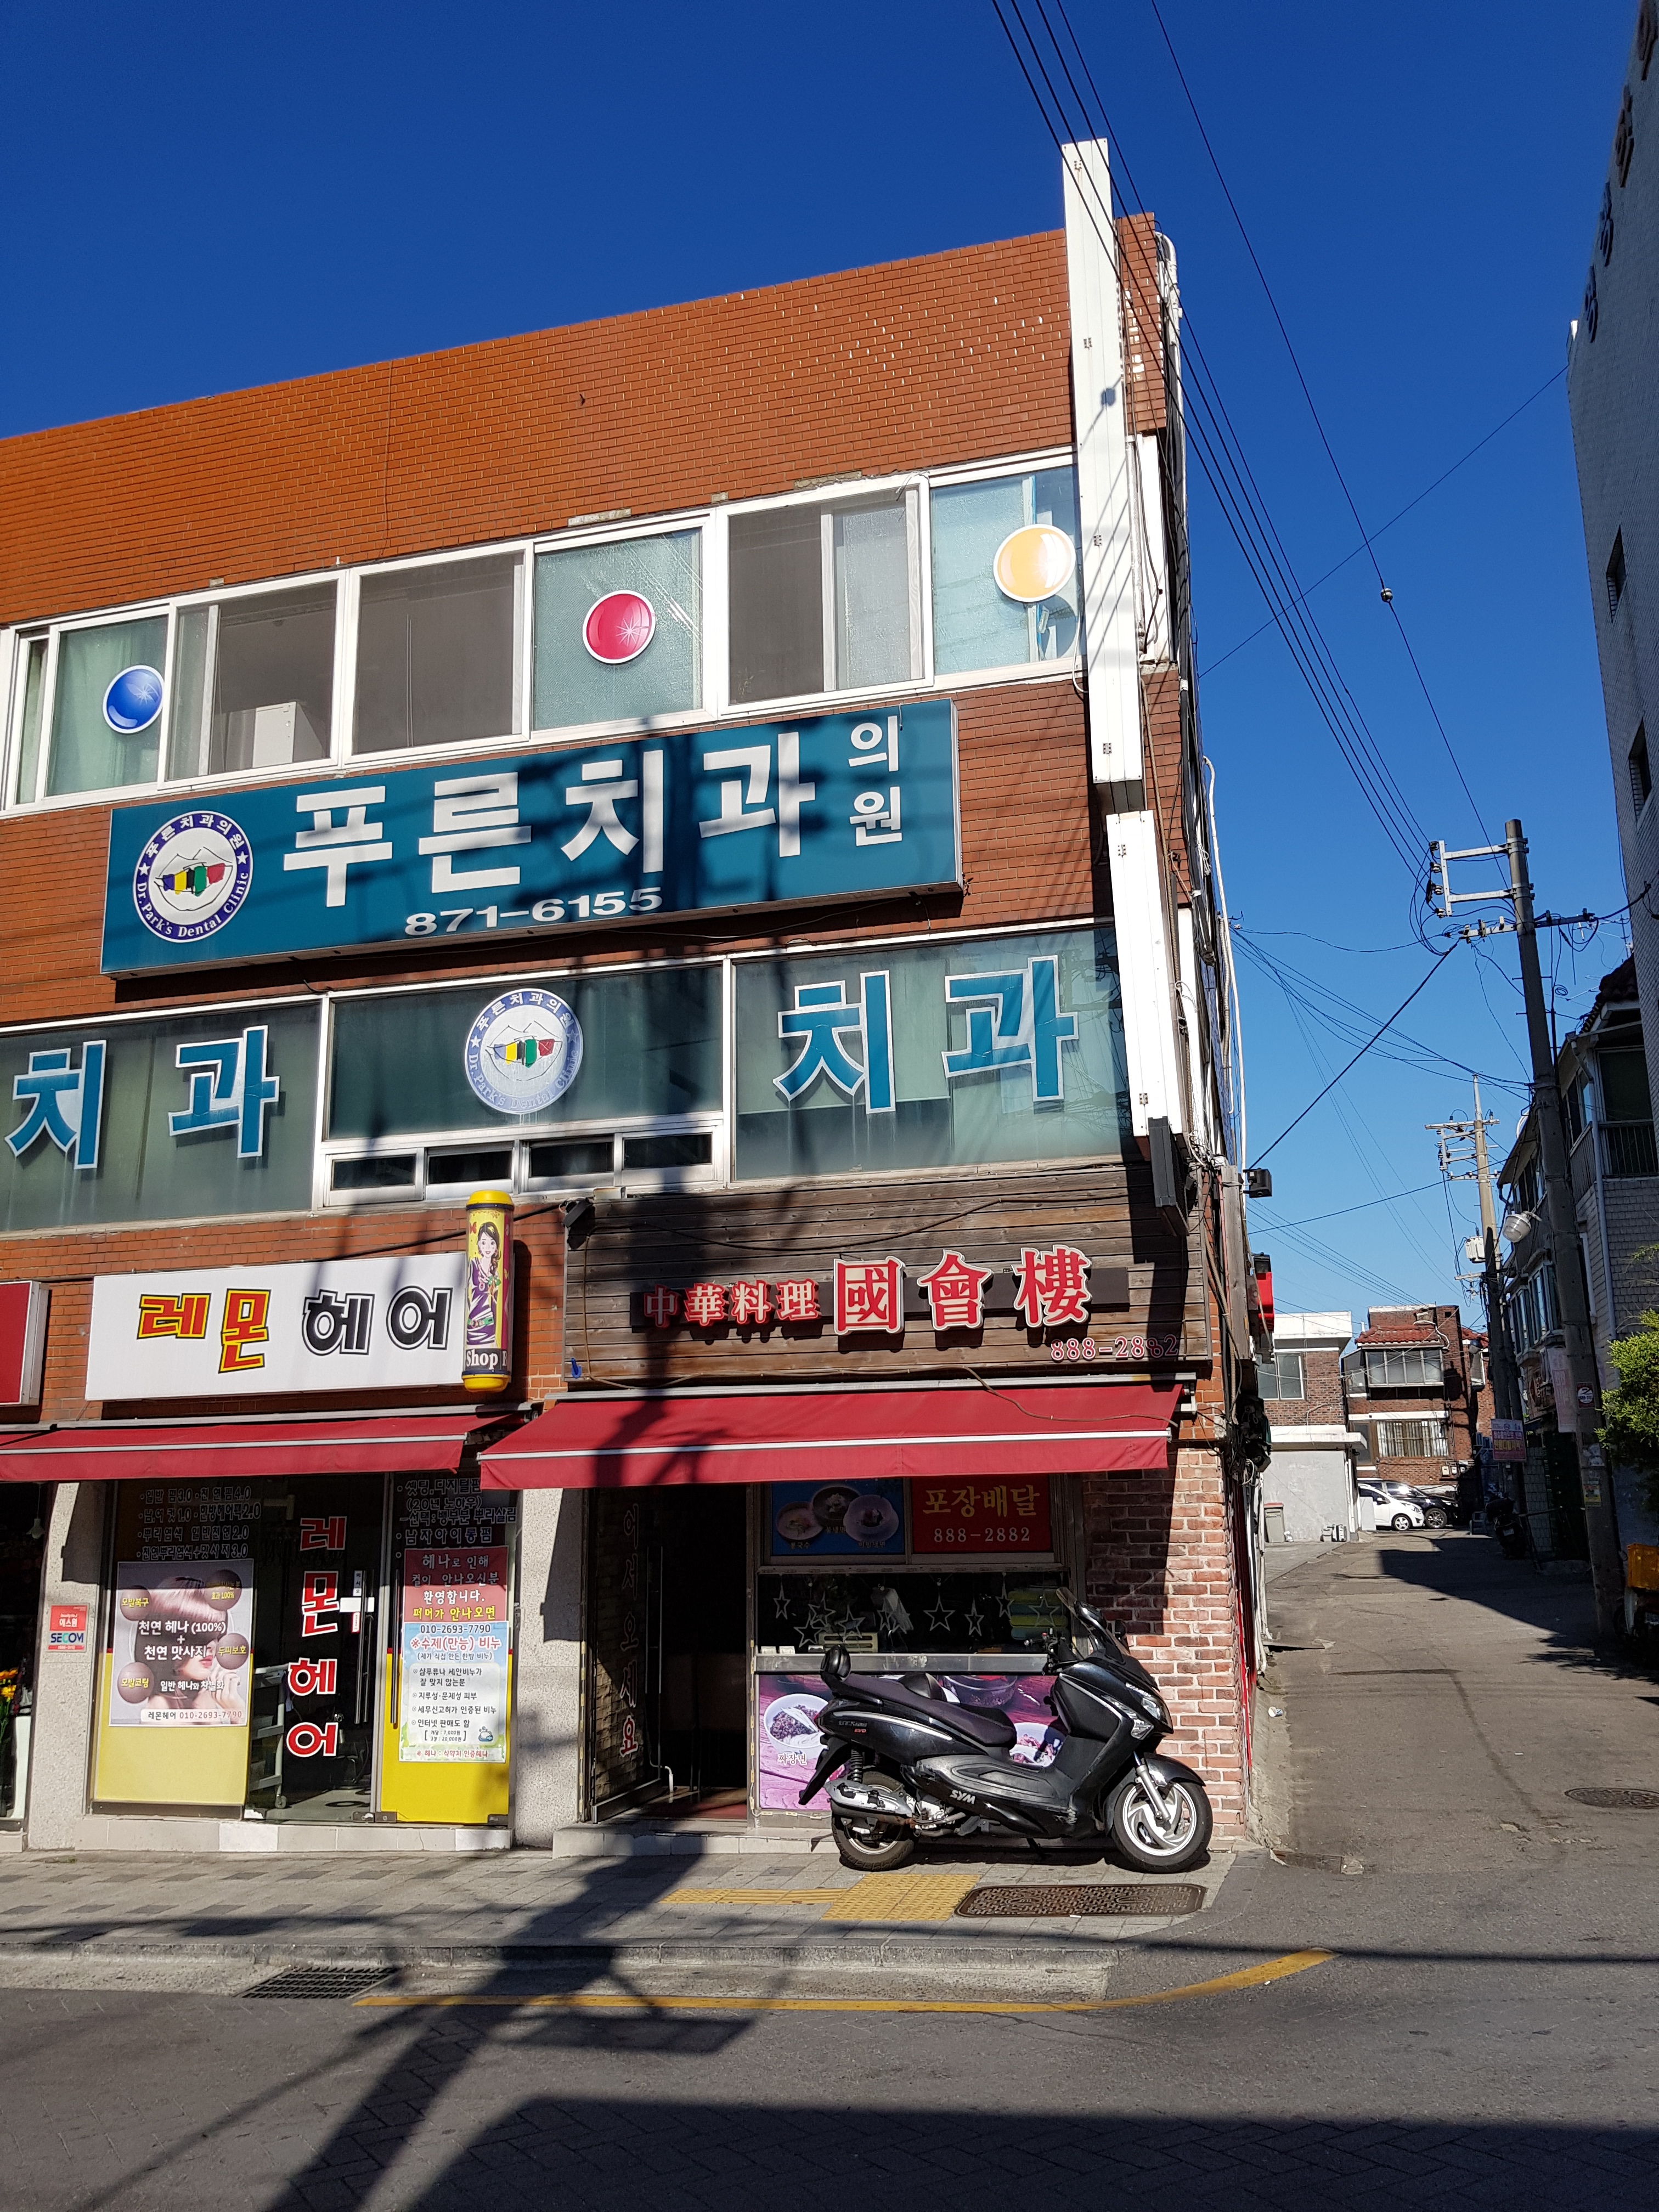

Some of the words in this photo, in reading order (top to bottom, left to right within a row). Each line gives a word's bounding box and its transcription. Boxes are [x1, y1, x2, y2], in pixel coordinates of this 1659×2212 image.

[283, 731, 815, 907] 푸른치과
[145, 814, 245, 859] 푸른치과의원
[137, 881, 147, 904] Dr.
[142, 902, 173, 935] Park's
[177, 914, 222, 937] Dental
[223, 872, 249, 913] Clinic
[405, 887, 663, 936] 871-6155
[476, 992, 574, 1031] 푸른치과의원
[772, 955, 1079, 1114] 치과
[469, 1053, 478, 1076] Dr.
[555, 1049, 579, 1089] Clinic
[4, 1025, 280, 1169] 치과
[473, 1074, 506, 1106] Park's
[510, 1089, 554, 1109] Dental
[643, 1278, 822, 1328] 中華料理
[833, 1244, 1093, 1335] 國會樓
[137, 1288, 272, 1374] 레몬
[302, 1285, 453, 1356] 헤어
[1051, 1333, 1180, 1362] 888-2882
[466, 1348, 498, 1370] Shop
[145, 1488, 164, 1504] 일반
[407, 1498, 441, 1511] (20년
[444, 1496, 482, 1510] 노하우)
[922, 1484, 1040, 1517] 포장배달
[934, 1527, 1031, 1544] 888-2882
[467, 1555, 489, 1570] 인해
[424, 1589, 485, 1605] 환영합니다.
[413, 1607, 444, 1621] 퍼머가
[50, 1632, 84, 1643] SECOM
[138, 1621, 161, 1635] 천연
[165, 1621, 189, 1634] 헤나
[191, 1621, 226, 1634] (100%)
[420, 1624, 490, 1634] 010-2693-7790
[619, 1503, 640, 1758] 어서오세요
[144, 1645, 168, 1660] 천연
[171, 1645, 207, 1660] 맛사지
[479, 1635, 501, 1650] 비누
[160, 1680, 176, 1692] 일반
[177, 1680, 199, 1690] 헤나와
[464, 1692, 477, 1700] 피부
[148, 1711, 177, 1720] 레몬헤어
[179, 1711, 242, 1719] 010-2693-7790
[483, 1706, 497, 1714] 비누
[950, 1790, 976, 1805] SYM
